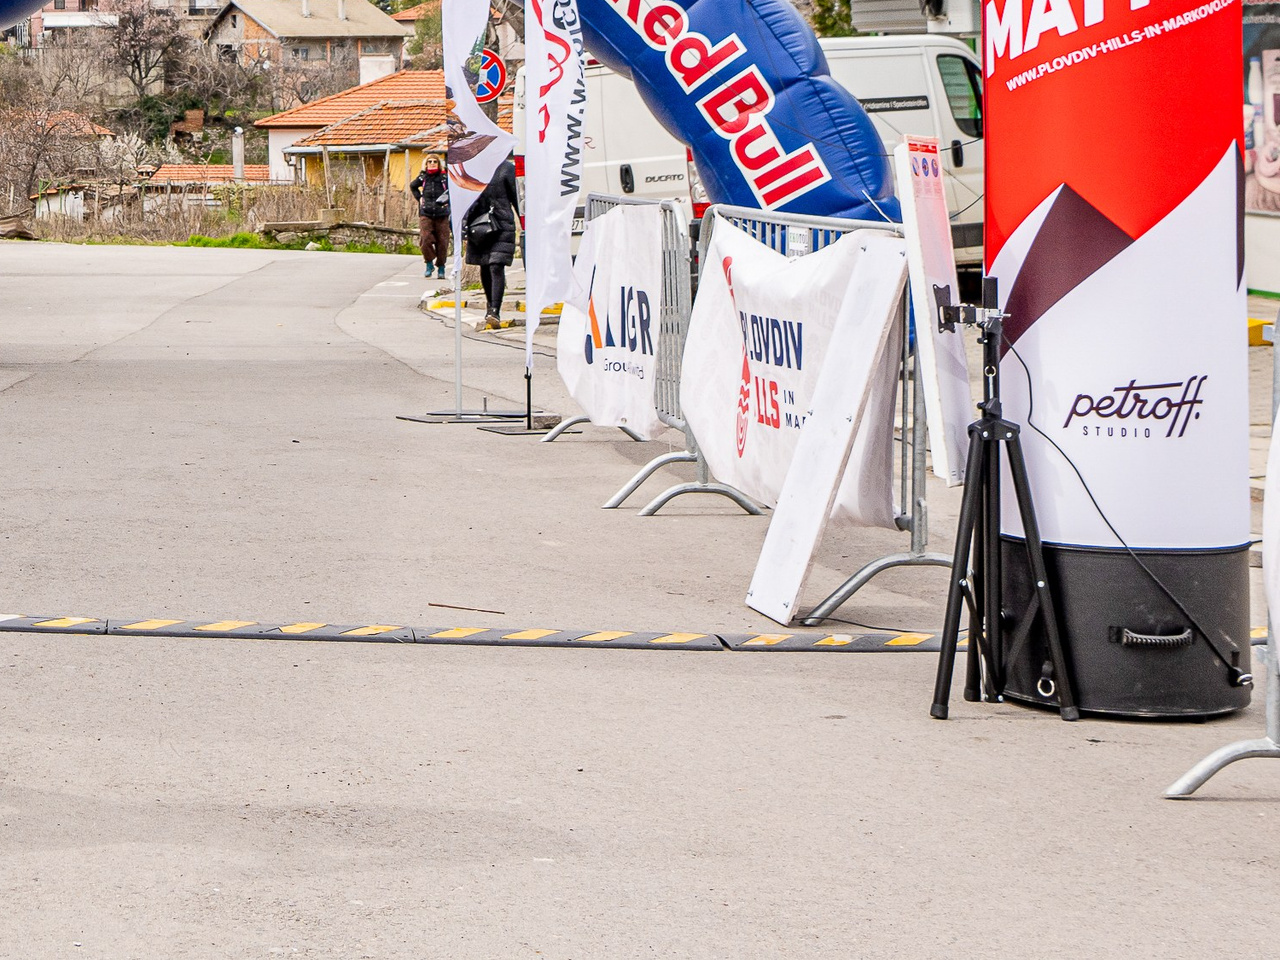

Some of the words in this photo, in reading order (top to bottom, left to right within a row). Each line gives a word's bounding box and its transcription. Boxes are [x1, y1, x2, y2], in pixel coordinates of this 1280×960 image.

[702, 71, 825, 207] Bull
[645, 174, 684, 183] DUCATO
[784, 390, 794, 405] IN
[1083, 426, 1151, 438] STUDIO
